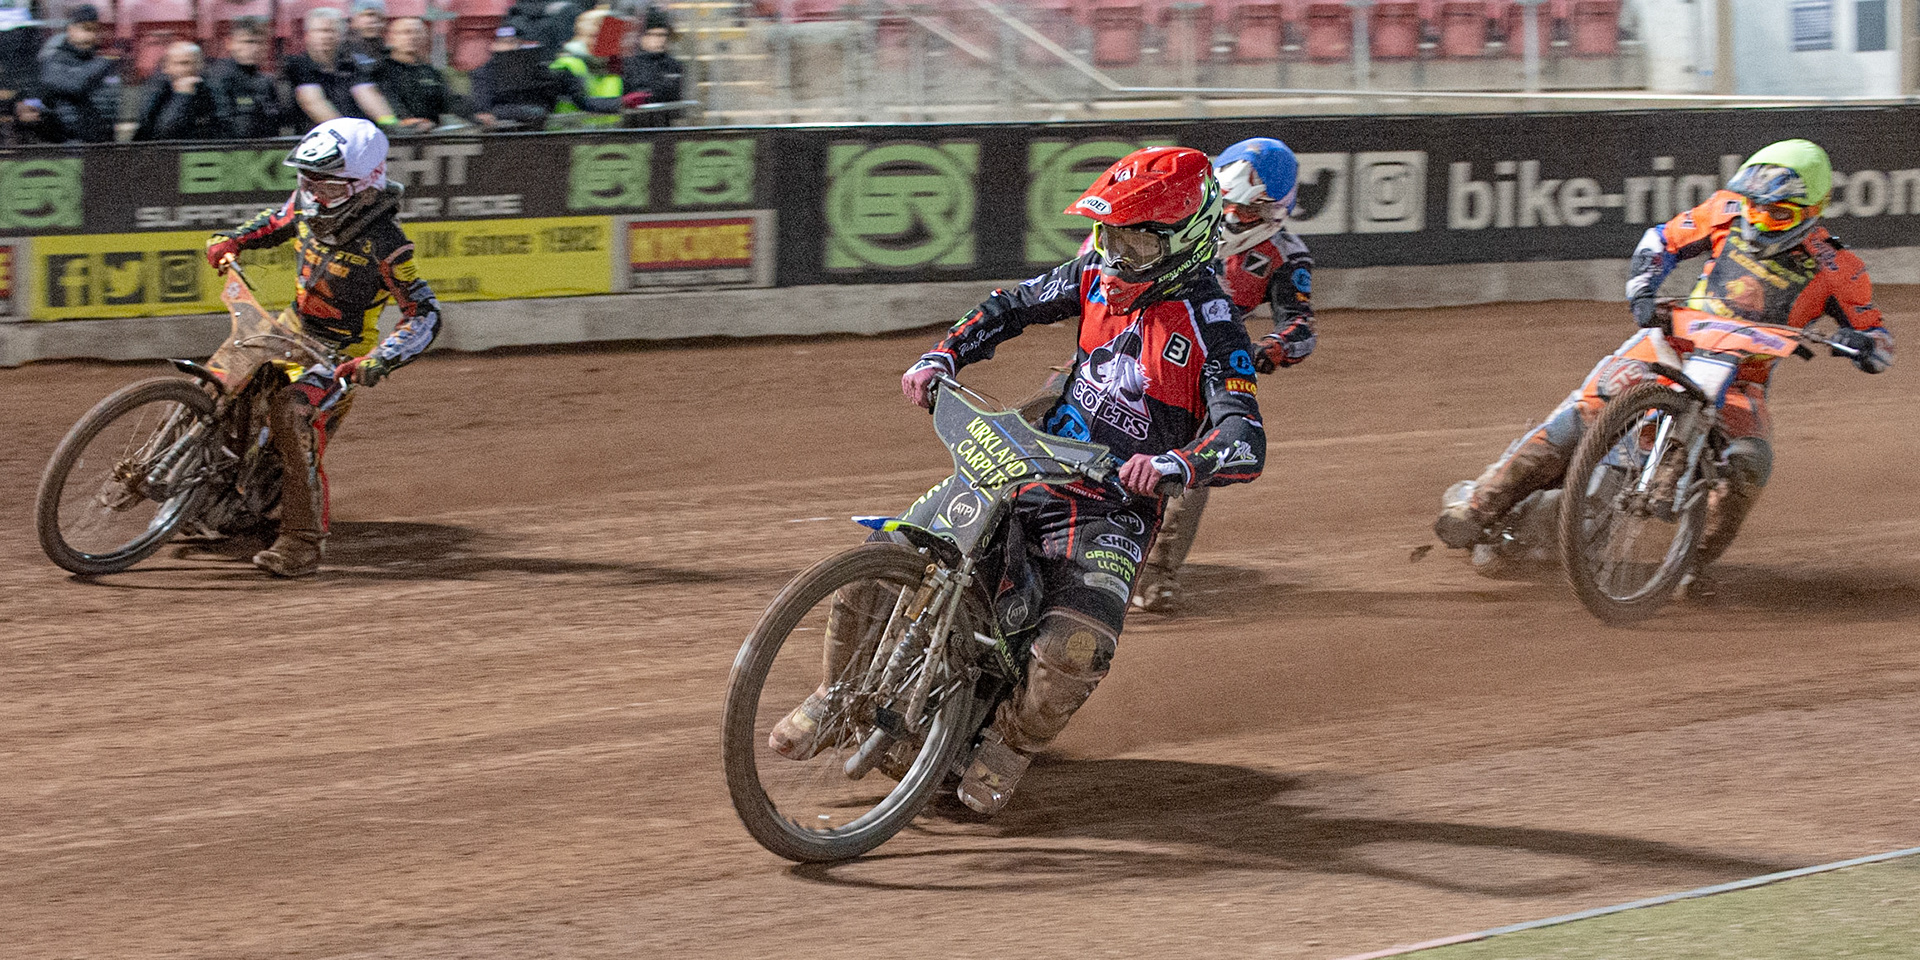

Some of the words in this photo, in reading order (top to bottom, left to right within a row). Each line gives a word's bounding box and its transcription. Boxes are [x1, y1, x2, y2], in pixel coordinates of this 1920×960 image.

[462, 229, 533, 257] since
[1171, 340, 1187, 361] 3
[1073, 377, 1151, 441] COLTS
[965, 415, 1028, 477] KIRKLAND
[952, 501, 976, 518] ATPI
[1099, 534, 1141, 562] SHOEI
[1084, 550, 1136, 577] GRAHAM
[1097, 560, 1131, 582] LLOYD
